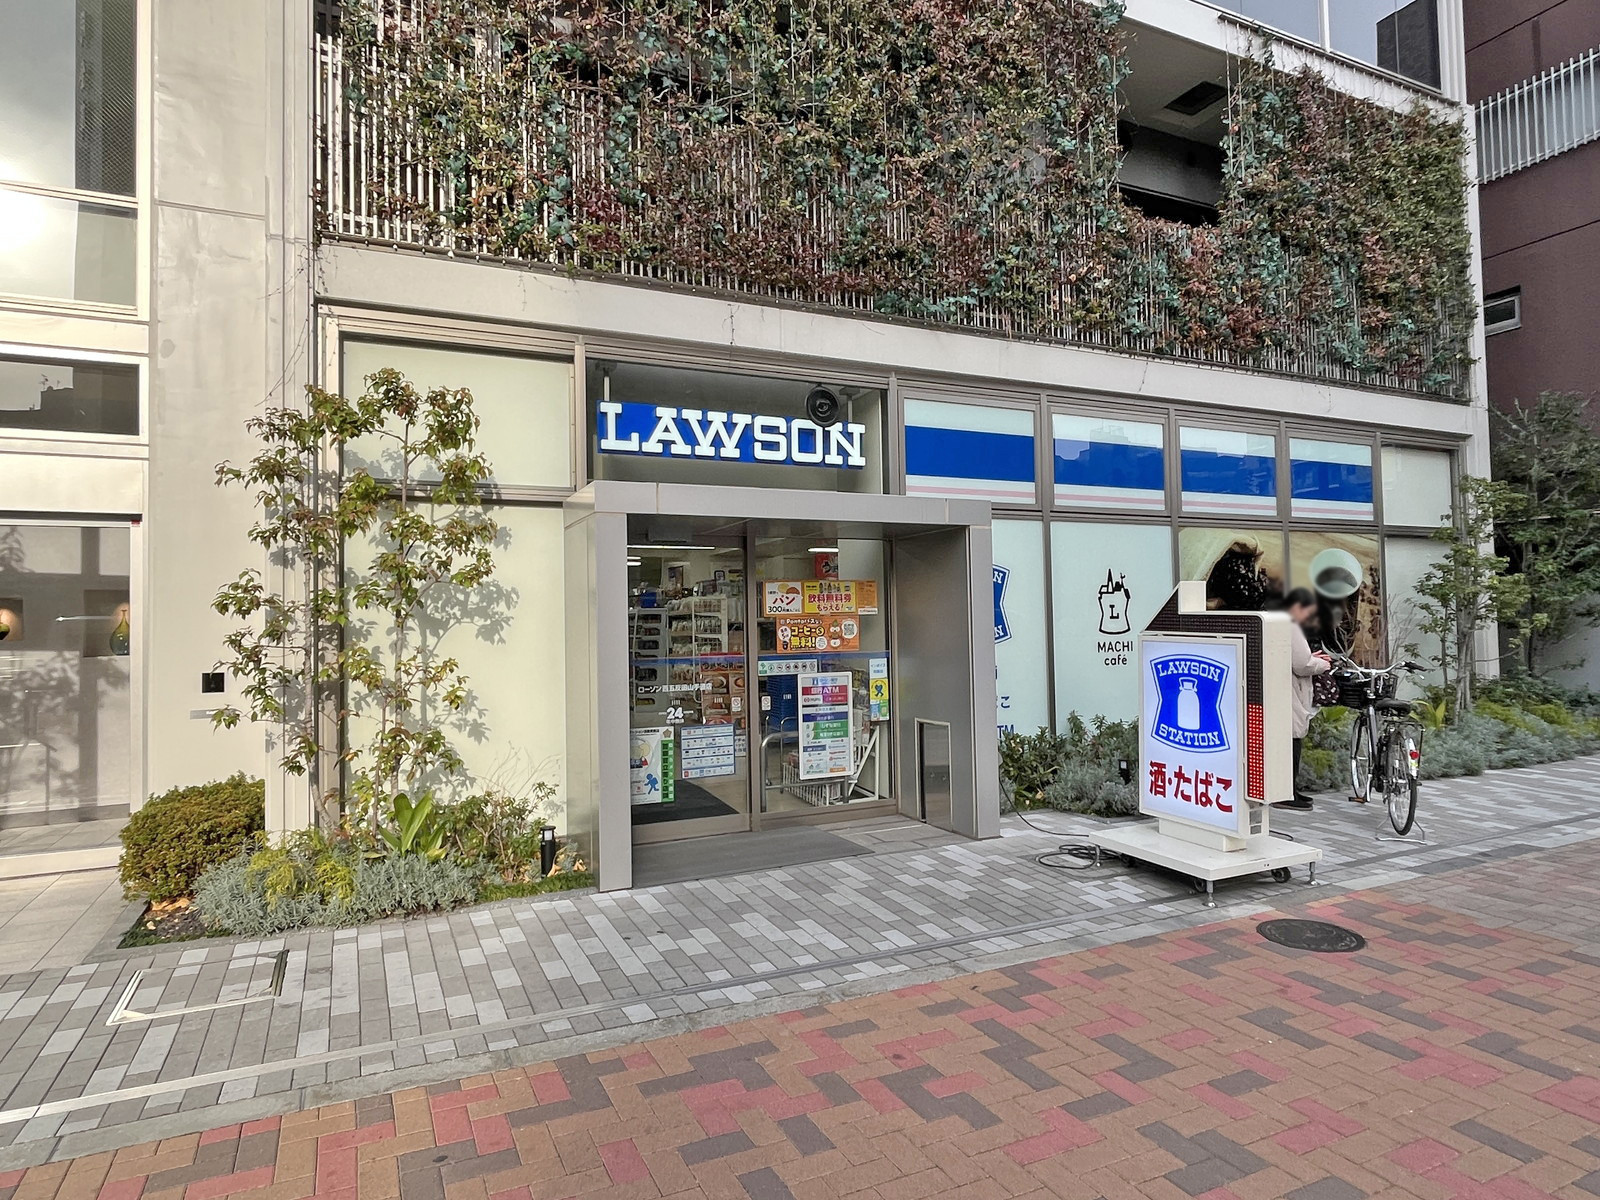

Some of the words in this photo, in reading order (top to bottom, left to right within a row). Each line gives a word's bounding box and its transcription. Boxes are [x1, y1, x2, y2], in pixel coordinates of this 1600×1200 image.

[600, 401, 866, 467] LAWSON
[772, 594, 796, 606] パン
[807, 593, 852, 604] 飲料無料券
[1109, 604, 1119, 619] L
[1097, 641, 1133, 653] MACHI
[1104, 654, 1128, 666] café
[1157, 660, 1221, 682] LAWSON
[666, 707, 684, 720] 24
[1158, 723, 1221, 746] STATION
[1149, 760, 1233, 813] 酒・たばこ
